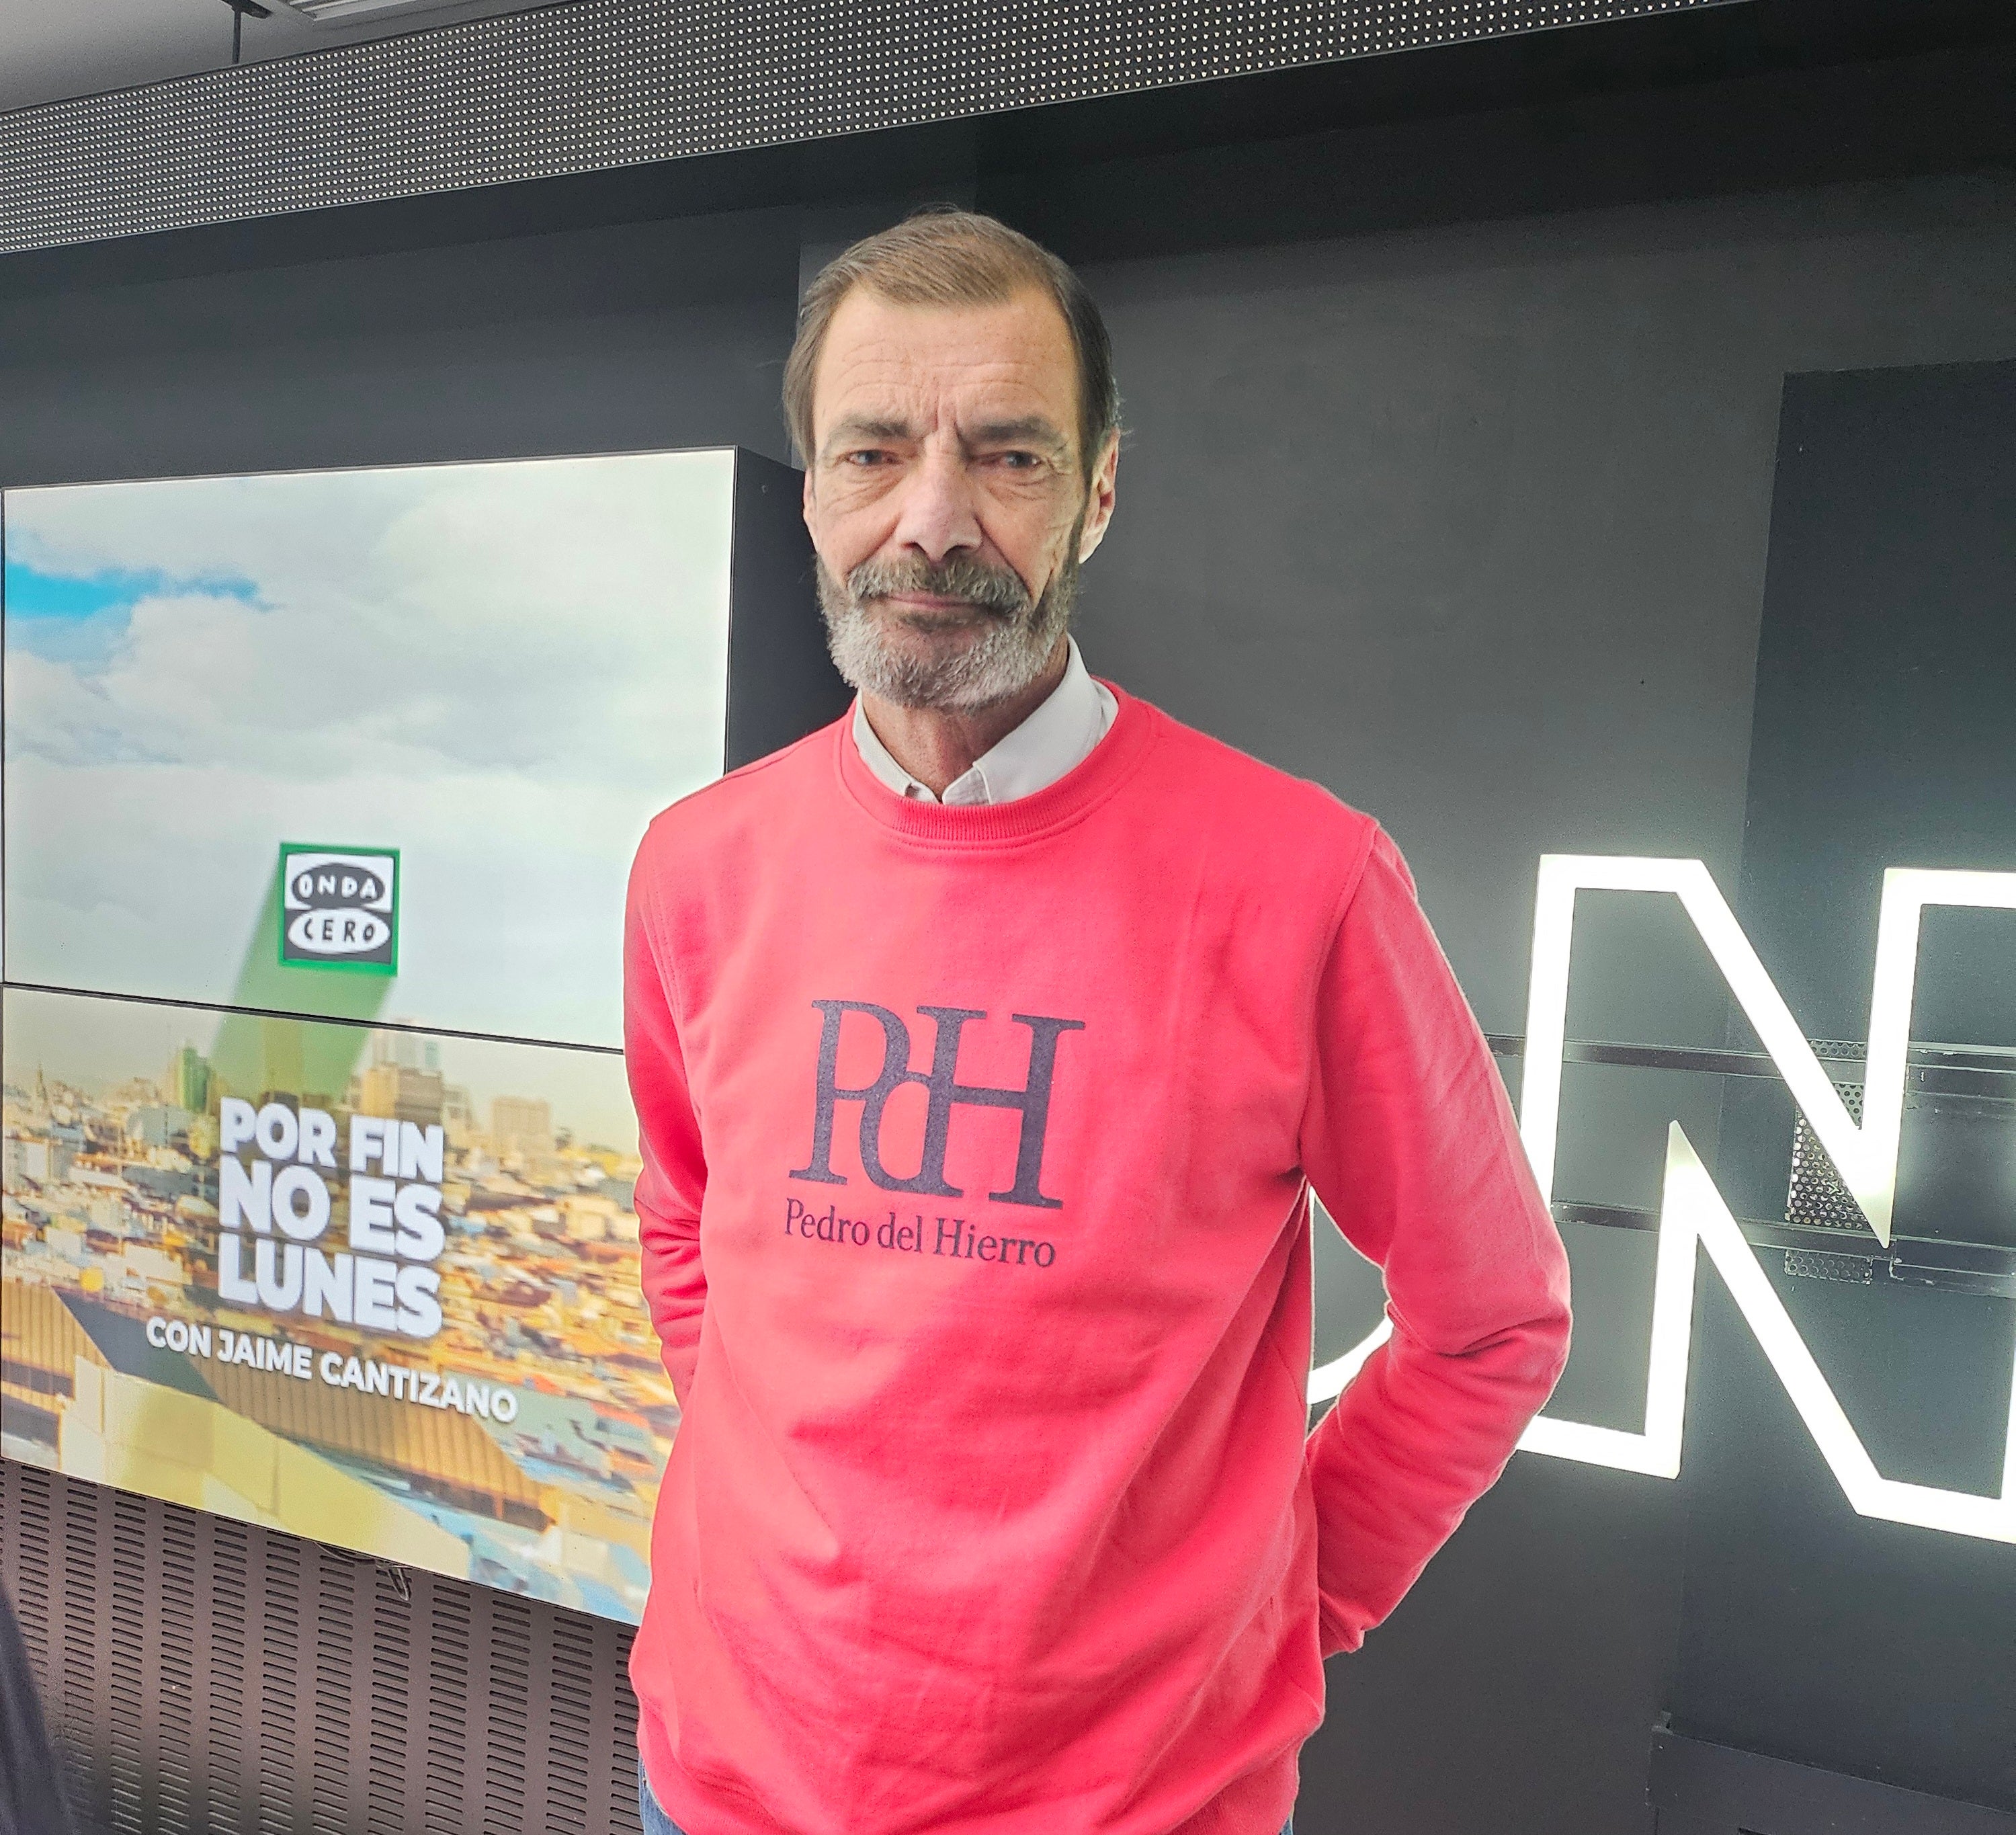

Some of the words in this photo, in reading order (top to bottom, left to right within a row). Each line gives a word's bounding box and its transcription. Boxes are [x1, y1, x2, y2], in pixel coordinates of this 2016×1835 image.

[298, 873, 377, 899] ONDA
[304, 918, 375, 942] CERO
[220, 1096, 338, 1168] POR
[349, 1114, 444, 1183] FIN
[219, 1155, 331, 1241] NO
[349, 1173, 446, 1262] ES
[784, 1197, 870, 1246] Pedro
[877, 1212, 923, 1254] del
[932, 1217, 1056, 1268] Hierro
[218, 1231, 444, 1339] LUNES
[145, 1315, 212, 1358] CON
[216, 1328, 314, 1380] JAIME
[320, 1352, 518, 1423] CANTIZANO
